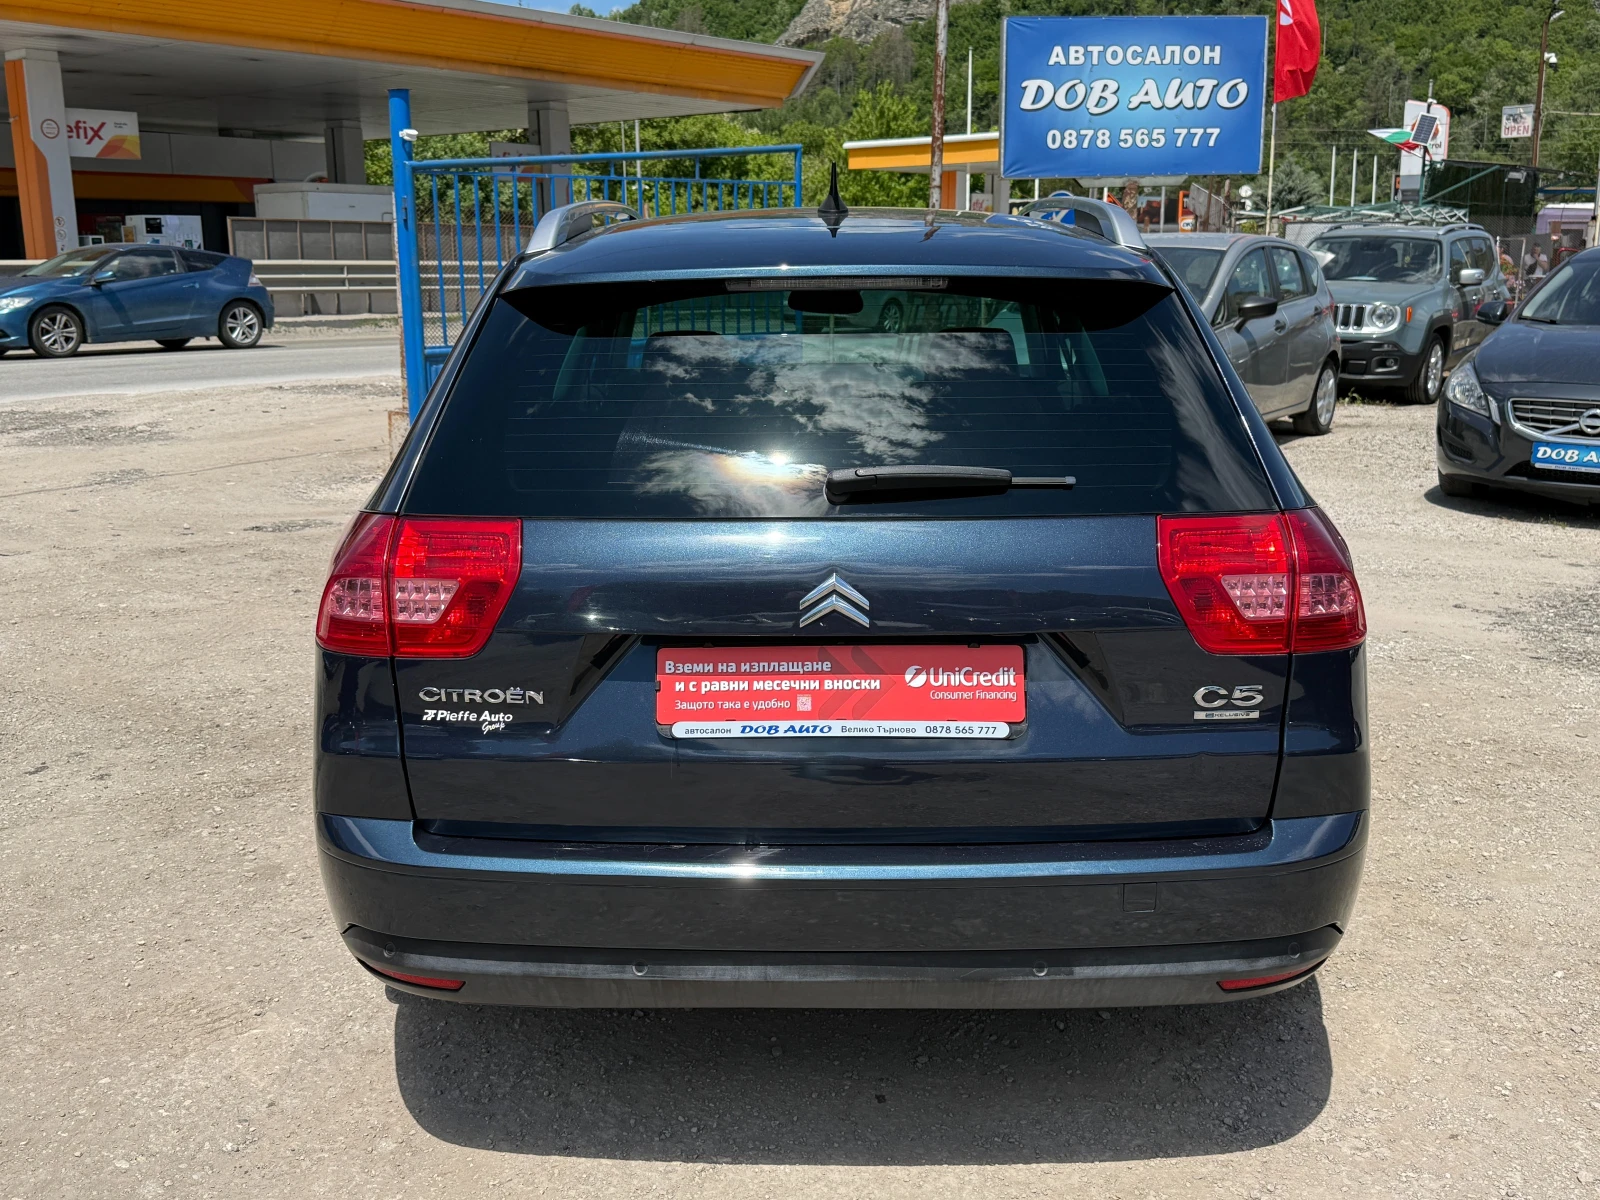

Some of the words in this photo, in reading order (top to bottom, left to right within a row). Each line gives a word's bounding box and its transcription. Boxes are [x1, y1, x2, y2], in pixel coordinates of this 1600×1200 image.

[1048, 45, 1221, 66] АВТОСАЛОН
[1019, 78, 1119, 115] DOB
[1127, 78, 1249, 110] AUTO
[1503, 125, 1530, 136] OPEN
[1046, 129, 1111, 149] 0878
[1118, 128, 1166, 148] 565
[1173, 128, 1221, 147] 777
[1536, 446, 1579, 463] DOB
[665, 661, 714, 673] Вземи
[718, 662, 736, 673] на
[741, 661, 832, 674] изплащане
[929, 666, 1017, 687] UniCredit
[675, 681, 685, 692] и
[689, 681, 697, 692] с
[701, 680, 749, 694] равни
[753, 679, 820, 691] месечни
[824, 679, 881, 691] вноски
[418, 686, 544, 705] CITROËN
[930, 690, 974, 700] Consumer
[976, 690, 1017, 702] Financing
[1193, 685, 1264, 708] C5
[675, 700, 715, 711] Защото
[717, 700, 741, 709] така
[743, 700, 750, 709] е
[752, 699, 791, 711] удобно
[436, 710, 478, 722] Pieffe
[479, 710, 514, 722] Auto
[481, 721, 506, 735] Group
[684, 727, 732, 735] автосалон
[740, 724, 780, 735] DOB
[783, 724, 832, 734] AUTO
[841, 725, 875, 733] Велико
[878, 725, 917, 735] Търново
[925, 725, 952, 734] 0878
[954, 725, 974, 735] 565
[977, 726, 997, 735] 777
